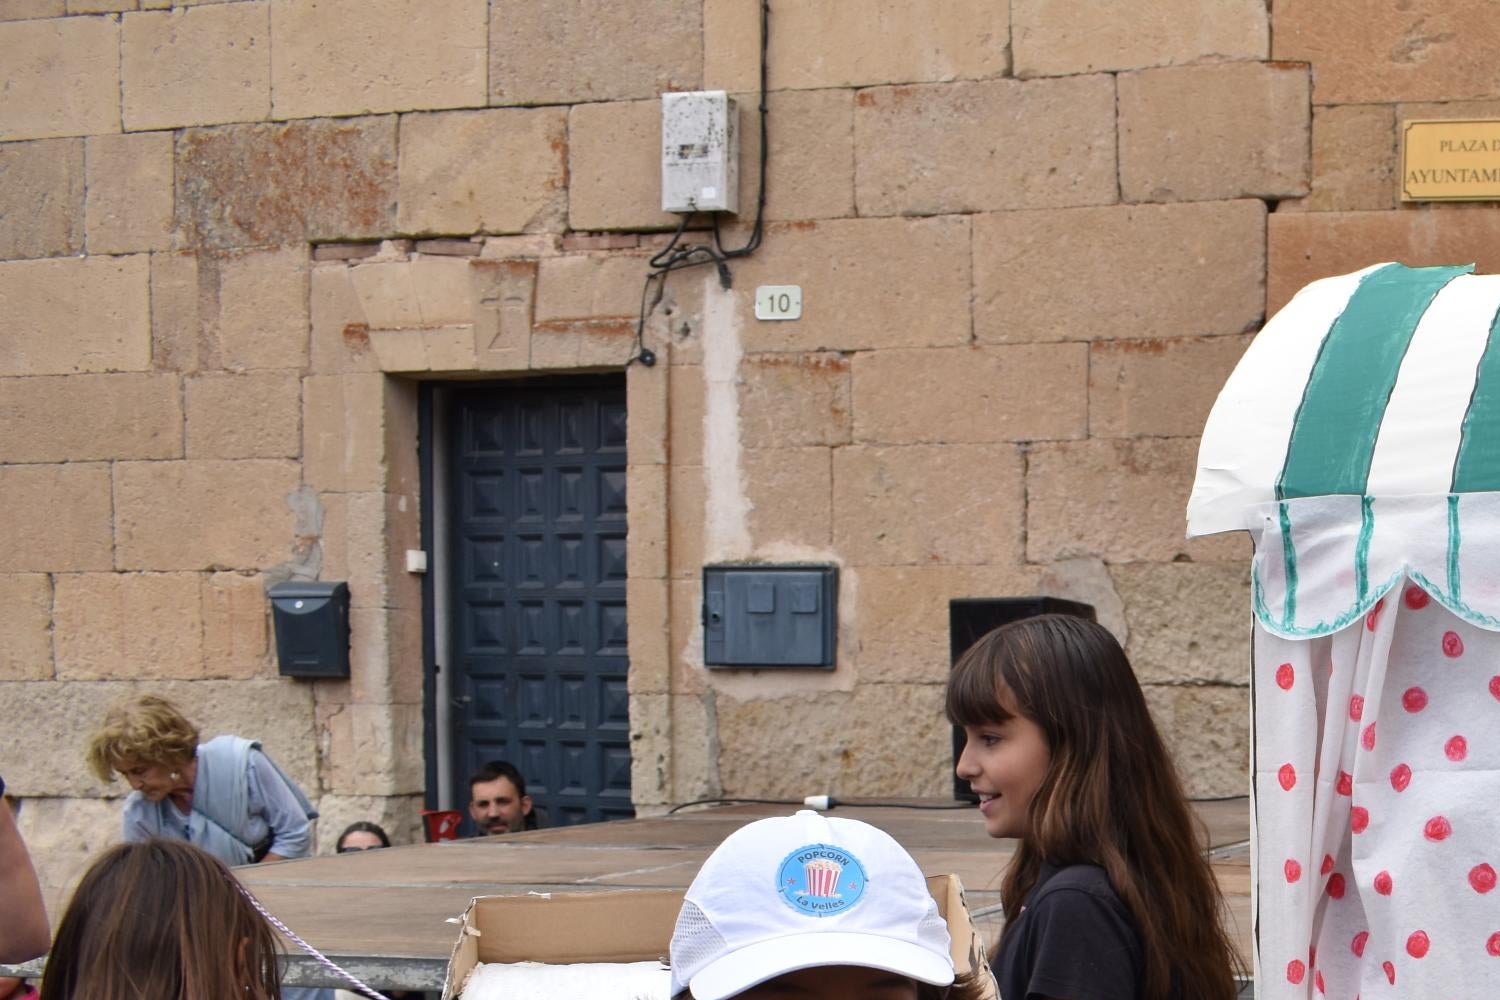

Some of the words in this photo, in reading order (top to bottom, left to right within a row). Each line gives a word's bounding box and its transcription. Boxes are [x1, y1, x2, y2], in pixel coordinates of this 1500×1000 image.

[1440, 140, 1488, 153] PLAZA
[767, 293, 791, 313] 10
[797, 850, 850, 867] POPCORN
